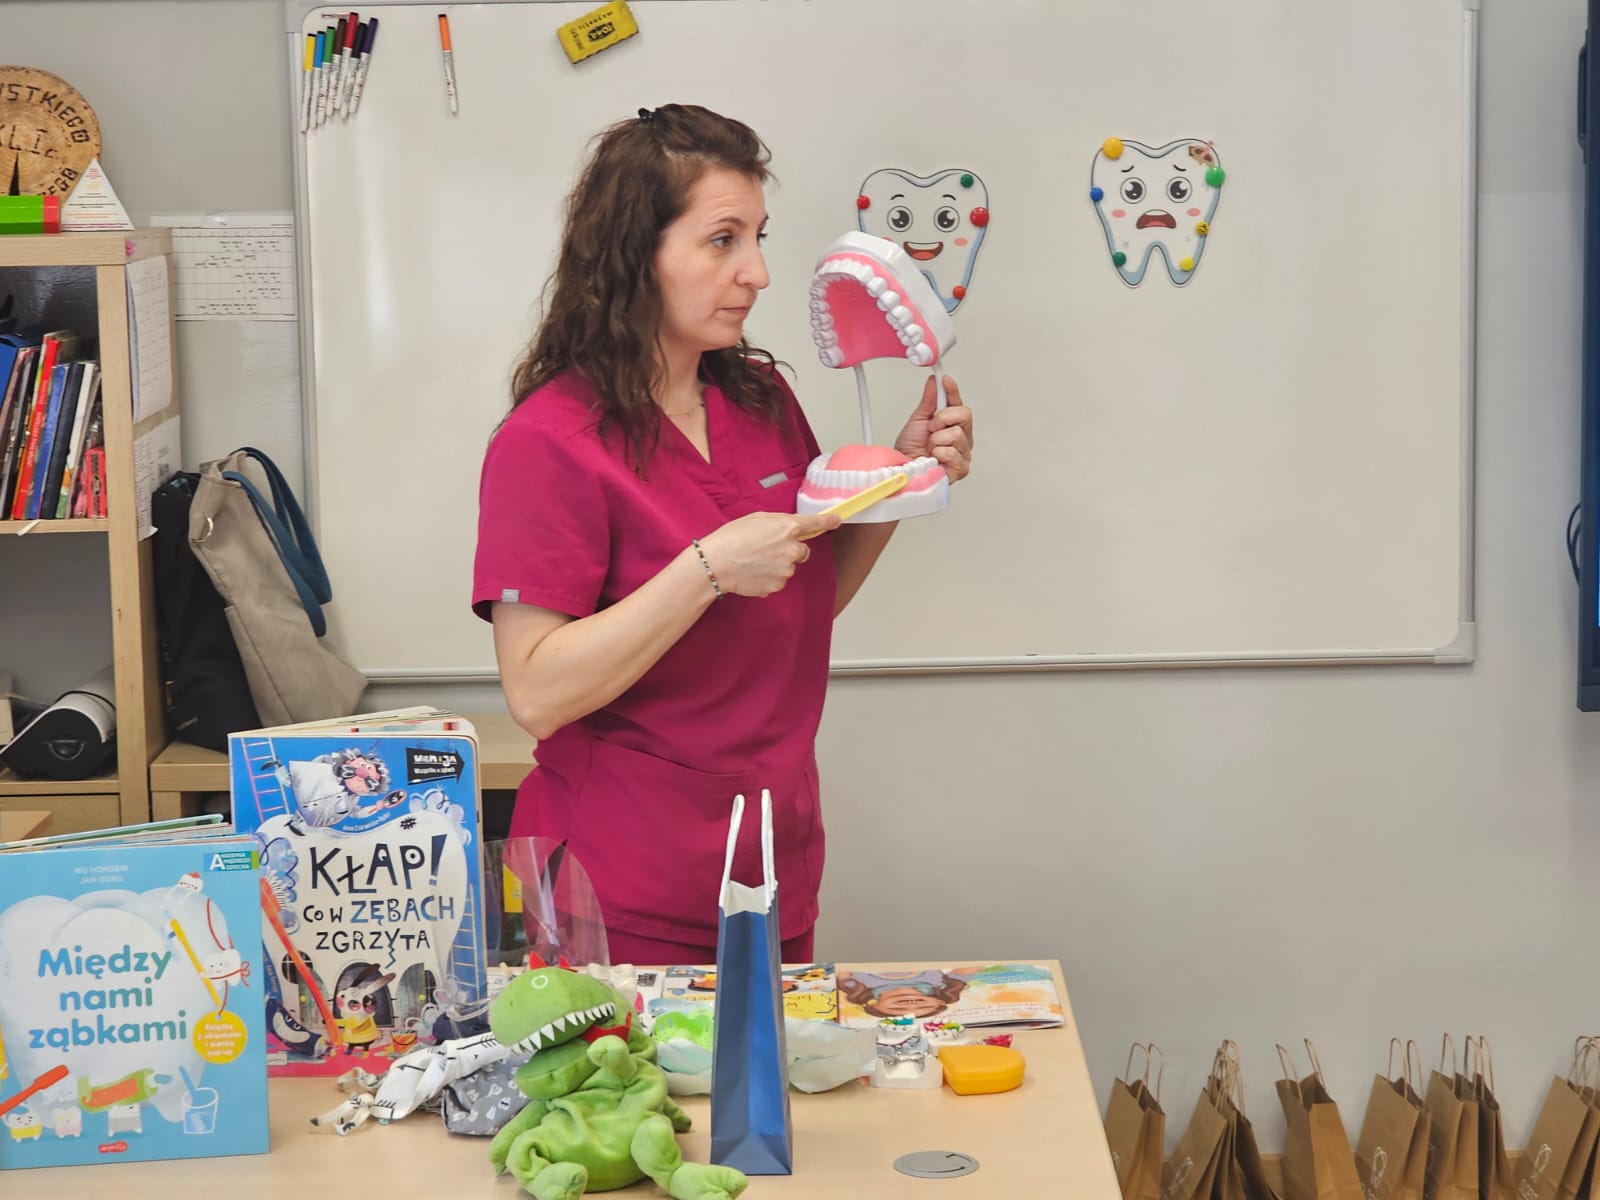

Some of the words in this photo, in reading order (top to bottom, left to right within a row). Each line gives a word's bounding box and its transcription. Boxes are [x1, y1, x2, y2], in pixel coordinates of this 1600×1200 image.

[309, 833, 448, 897] KŁAP!
[330, 906, 343, 924] W
[350, 895, 455, 926] ZĘBACH
[316, 927, 430, 955] ZGRZYTA
[37, 944, 172, 981] Między
[59, 976, 153, 1012] nami
[28, 1009, 187, 1053] ząbkami
